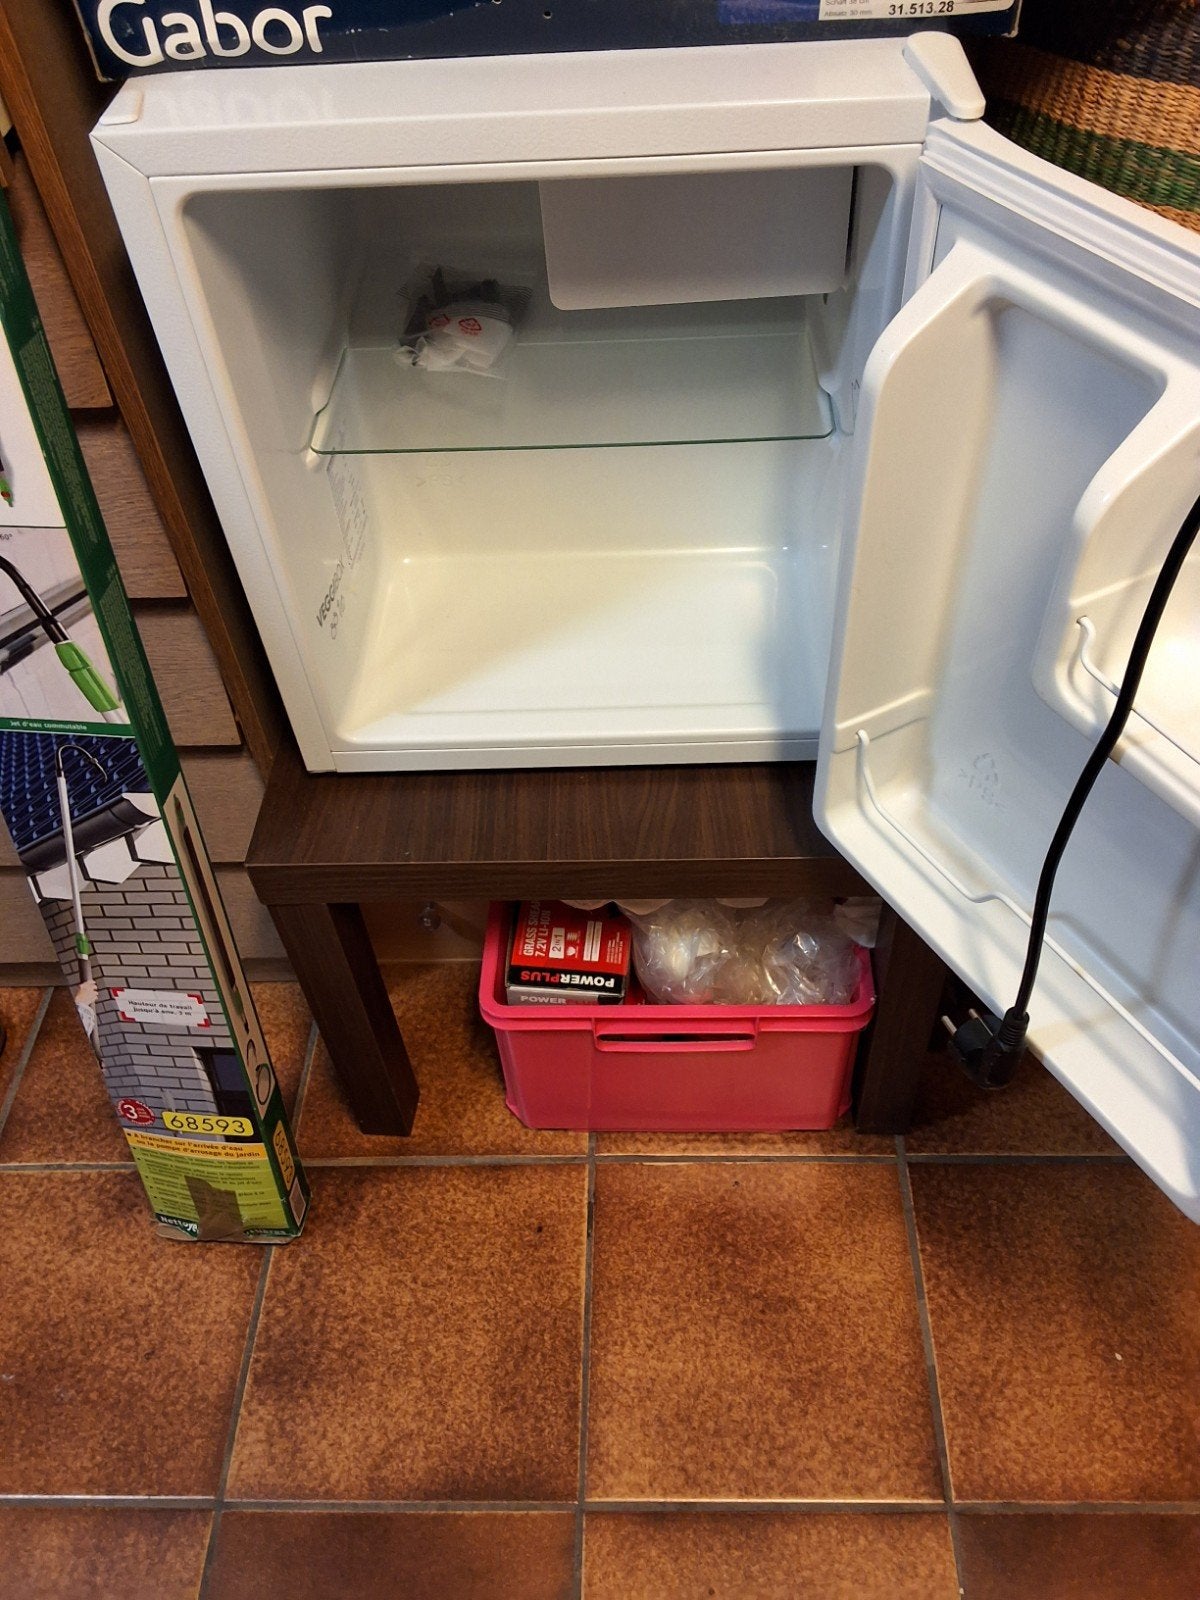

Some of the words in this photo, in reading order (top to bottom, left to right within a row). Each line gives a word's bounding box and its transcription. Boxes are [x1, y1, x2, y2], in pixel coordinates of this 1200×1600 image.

[888, 1, 955, 15] 31.513.28
[97, 0, 333, 67] Gabor
[520, 970, 616, 988] POWERPLUS
[123, 1104, 138, 1119] 3
[170, 1115, 246, 1134] 68593
[160, 1215, 199, 1233] Nettoye
